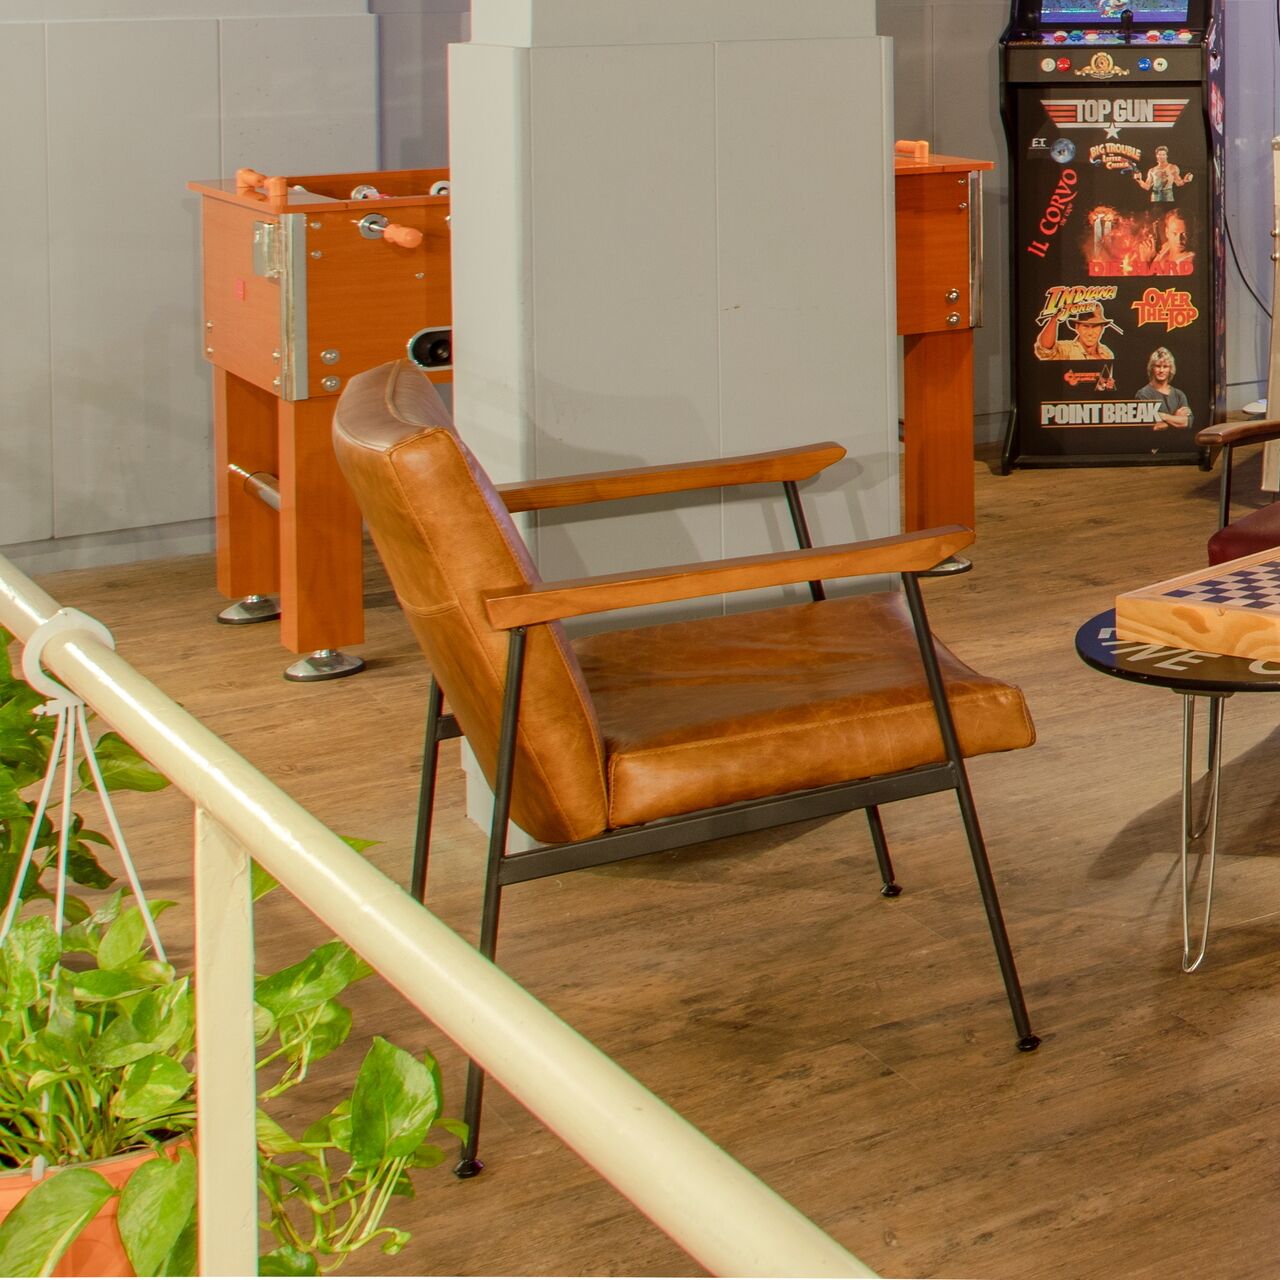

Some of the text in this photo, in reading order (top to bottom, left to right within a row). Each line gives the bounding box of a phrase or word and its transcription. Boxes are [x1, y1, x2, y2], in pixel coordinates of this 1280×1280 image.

[1076, 99, 1153, 122] TOP GUN
[1089, 142, 1142, 161] BIG TROUBLE
[1027, 240, 1050, 258] IL
[1039, 168, 1078, 236] CORVO
[1088, 259, 1194, 276] DIE HARD
[1042, 285, 1118, 317] INDIANA
[1143, 288, 1192, 309] OVER
[1131, 300, 1199, 332] THE TOP
[1041, 402, 1162, 425] POINT BREAK
